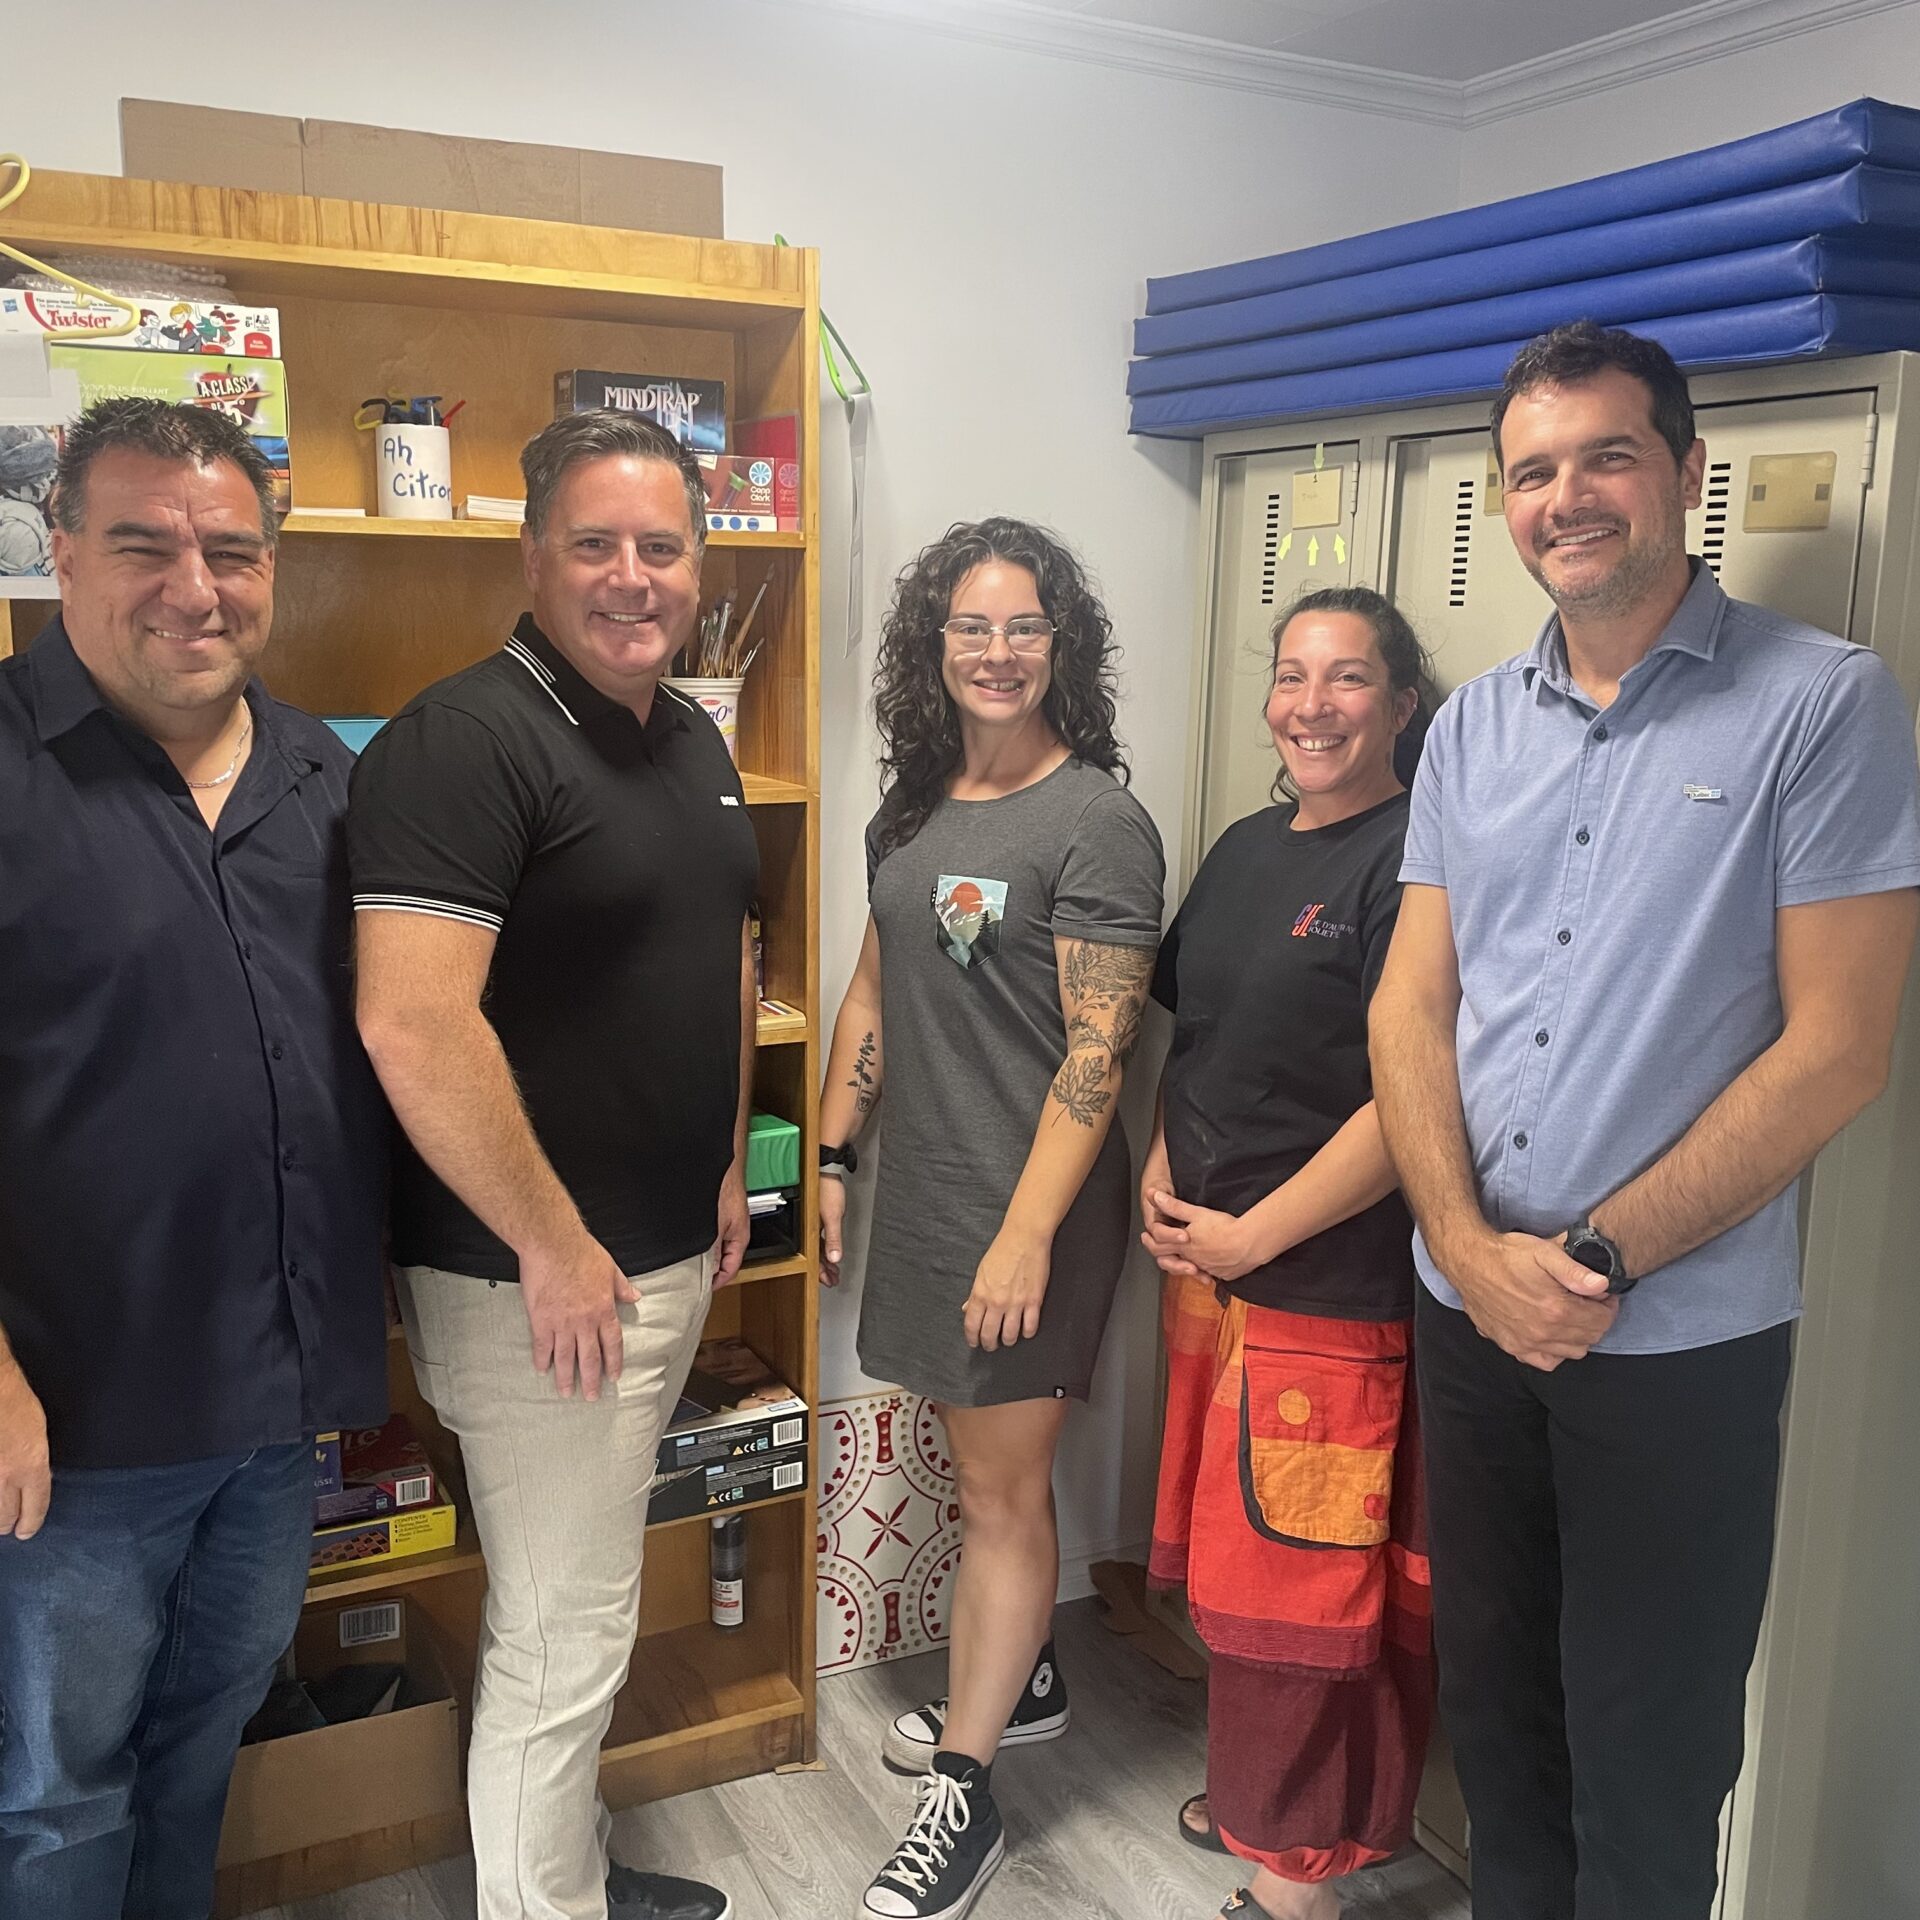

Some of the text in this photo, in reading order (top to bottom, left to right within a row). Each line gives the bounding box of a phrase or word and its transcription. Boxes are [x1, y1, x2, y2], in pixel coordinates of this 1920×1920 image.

[46, 309, 112, 329] Twister
[603, 383, 701, 415] MINDTRAP
[383, 434, 413, 467] Ah
[1321, 921, 1357, 936] D'AURAY
